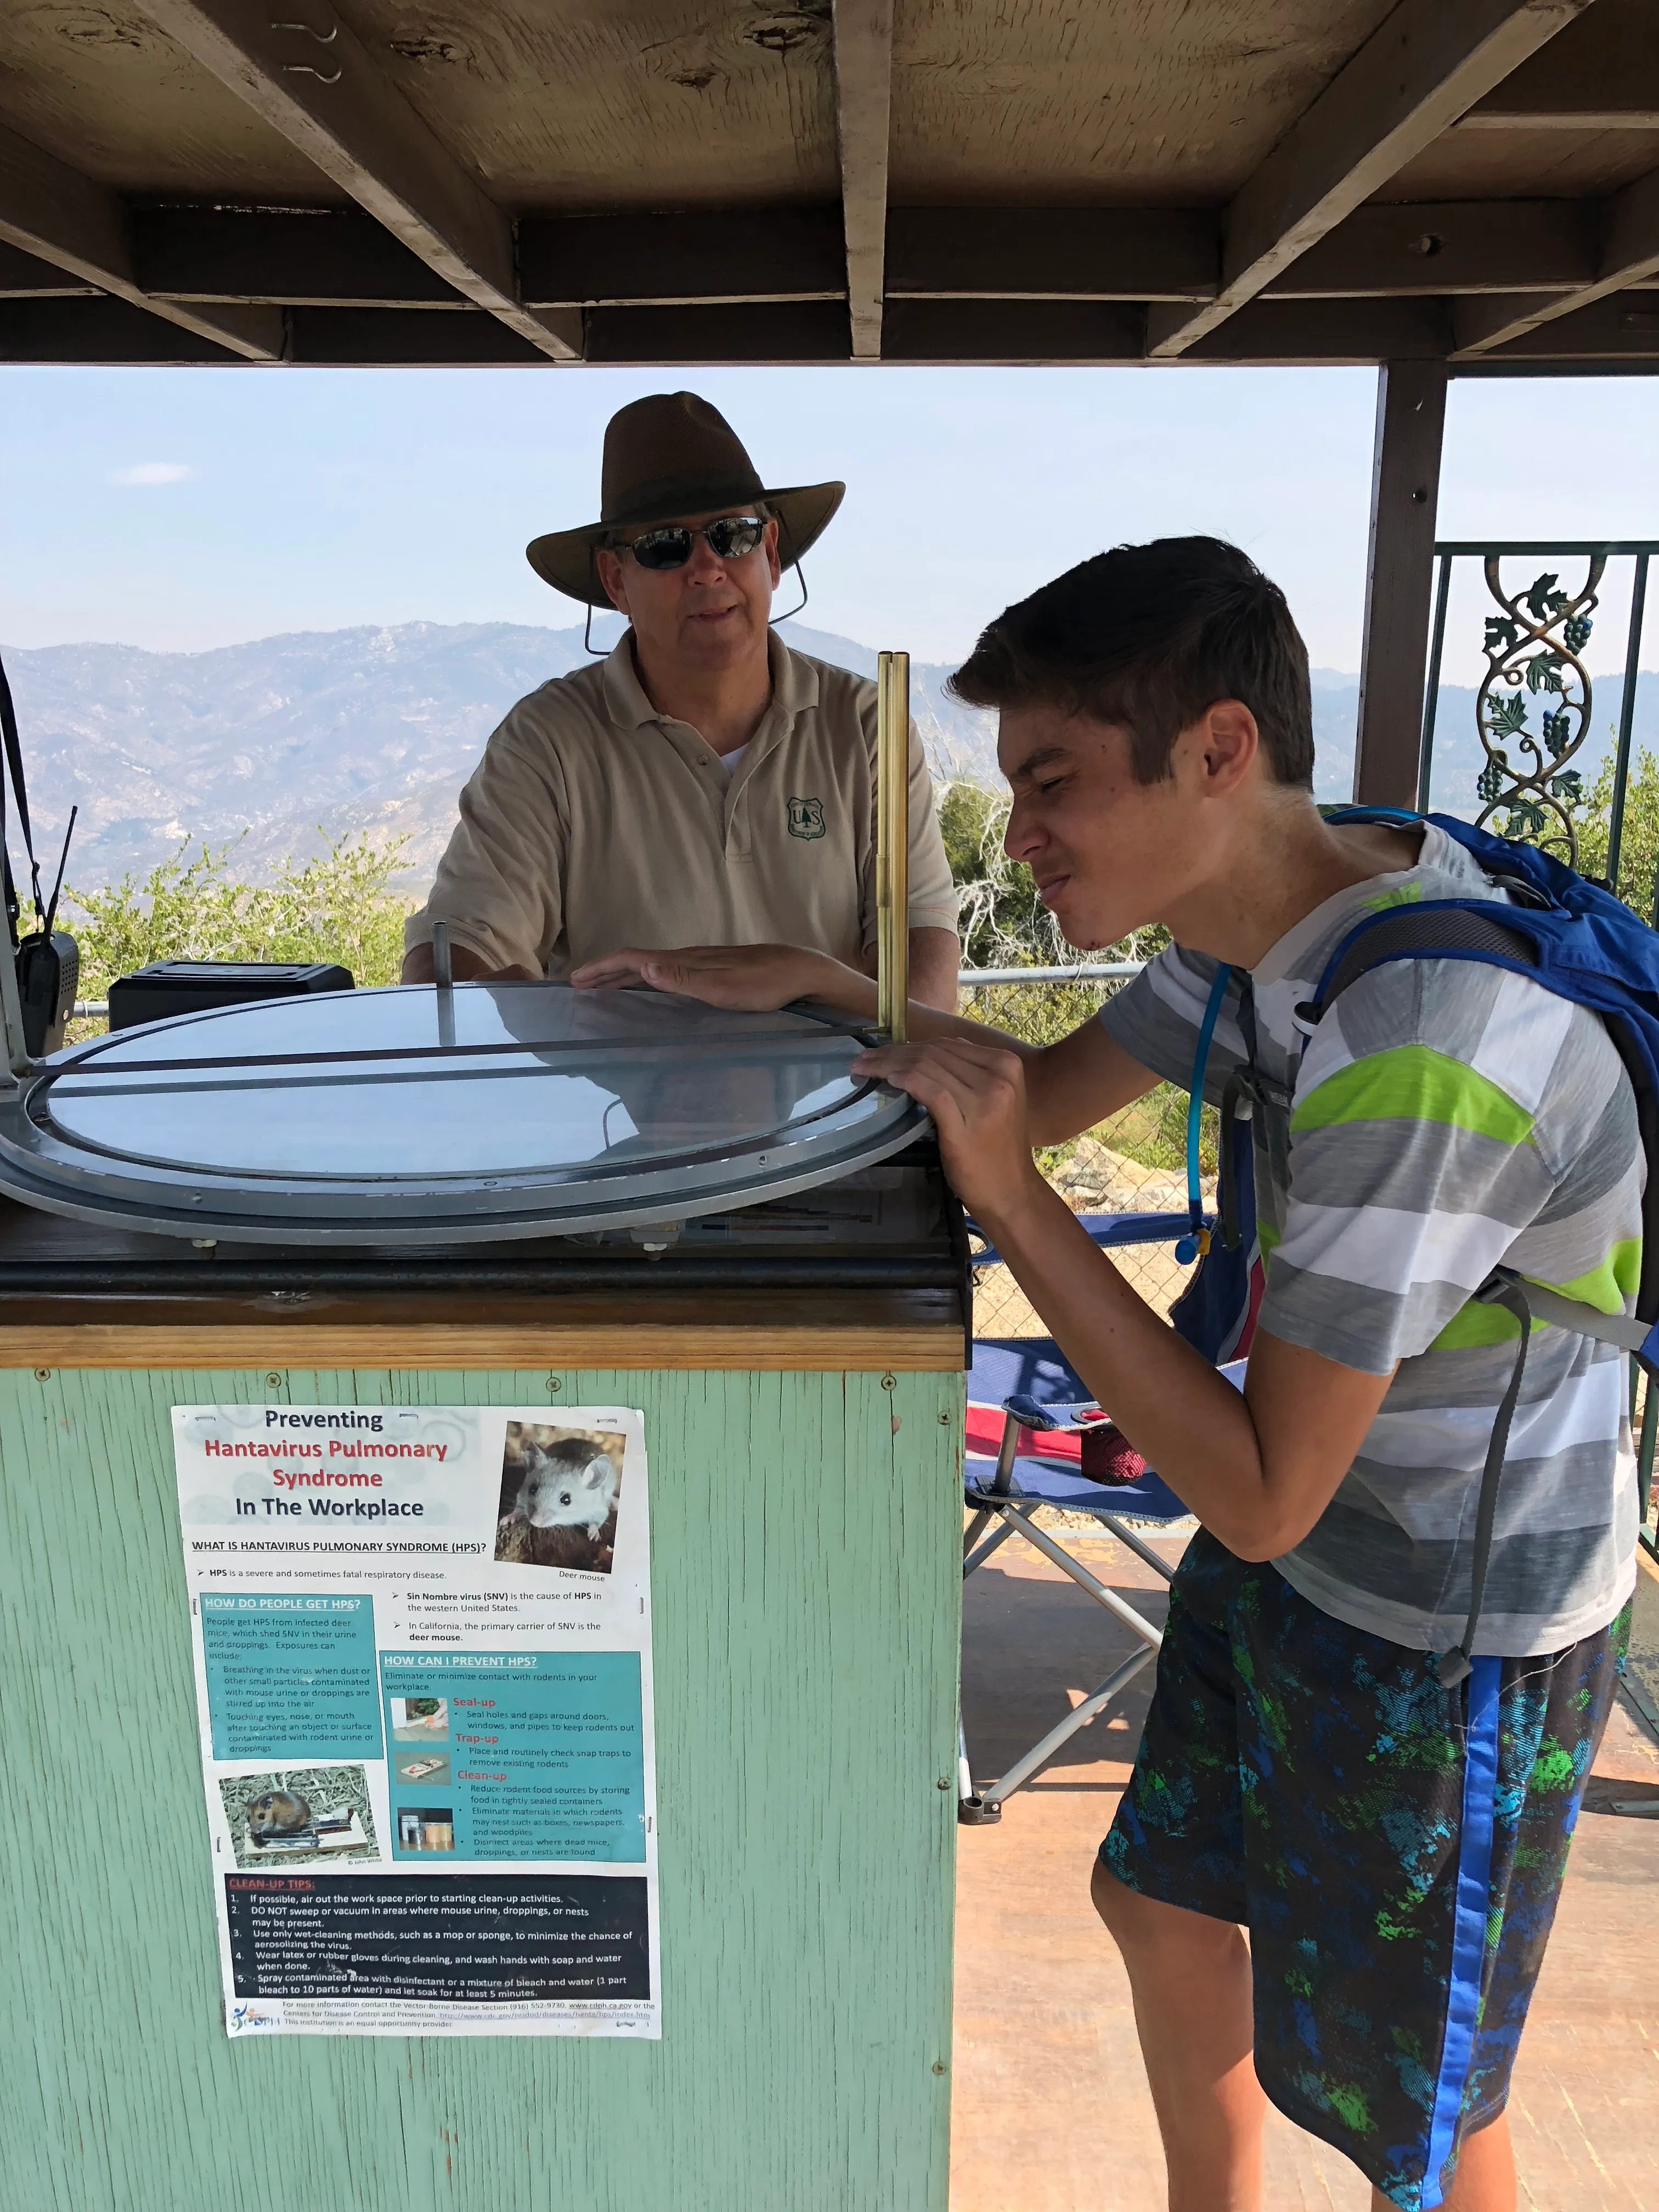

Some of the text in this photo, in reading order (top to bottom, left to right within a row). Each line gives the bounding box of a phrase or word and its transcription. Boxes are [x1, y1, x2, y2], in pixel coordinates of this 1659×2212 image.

[265, 1409, 383, 1432] Preventing
[203, 1439, 448, 1462] Hantavirus Pulmonary
[272, 1469, 383, 1491] Syndrome
[235, 1497, 424, 1520] In The Workplace
[191, 1541, 487, 1553] WHAT IS HANTAVIRUS PULMONARY SYNDROME (HPS)?
[209, 1568, 227, 1577] HPS
[229, 1568, 236, 1577] is
[275, 1569, 292, 1578] and
[294, 1569, 341, 1578] sometimes
[342, 1570, 362, 1578] fatal
[364, 1570, 411, 1581] respiratory
[412, 1570, 447, 1579] disease.
[559, 1571, 605, 1582] Deer mouse
[483, 1593, 508, 1602] (SNV)
[562, 1592, 572, 1600] of
[574, 1592, 591, 1600] HPS
[594, 1592, 601, 1600] in
[205, 1598, 360, 1609] HOW DO PEOPLE GET HPS?
[407, 1604, 422, 1612] the
[460, 1604, 489, 1612] United
[492, 1604, 520, 1612] States.
[206, 1617, 235, 1627] People
[237, 1618, 251, 1627] get
[253, 1618, 270, 1626] HPS
[331, 1619, 351, 1627] deer
[408, 1622, 601, 1632] In California, the primary carrier of SNV is the
[409, 1633, 429, 1641] deer
[384, 1656, 537, 1667] HOW CAN I PREVENT HPS?
[385, 1672, 424, 1680] Eliminate
[478, 1673, 510, 1681] contact
[511, 1673, 531, 1681] with
[533, 1673, 566, 1681] rodents
[452, 1697, 496, 1709] Seal-up
[454, 1733, 499, 1746] Trap-up
[457, 1770, 507, 1782] Clean-up
[503, 1785, 531, 1793] rodent
[533, 1785, 552, 1793] food
[588, 1786, 598, 1795] by
[601, 1786, 630, 1796] storing
[229, 1879, 315, 1889] CLEAN-UP TIPS:
[230, 1893, 563, 1905] 1. If possible, air out the work space prior to starting clean-up activities.
[251, 1906, 266, 1915] DO
[267, 1906, 287, 1915] NOT
[289, 1908, 319, 1917] sweep
[371, 1906, 381, 1915] in
[409, 1906, 439, 1915] where
[473, 1906, 500, 1916] urine,
[503, 1906, 551, 1917] droppings,
[565, 1906, 589, 1916] nests
[252, 1918, 324, 1929] may be present.
[253, 1928, 270, 1937] Use
[294, 1929, 352, 1940] wet-cleaning
[354, 1929, 397, 1940] methods,
[399, 1930, 420, 1939] such
[443, 1932, 464, 1941] mop
[477, 1933, 514, 1942] sponge,
[515, 1931, 526, 1939] to
[527, 1931, 568, 1939] minimize
[571, 1931, 586, 1939] the
[588, 1931, 621, 1939] chance
[622, 1931, 633, 1939] of
[255, 1940, 352, 1951] aerosolizing the virus.
